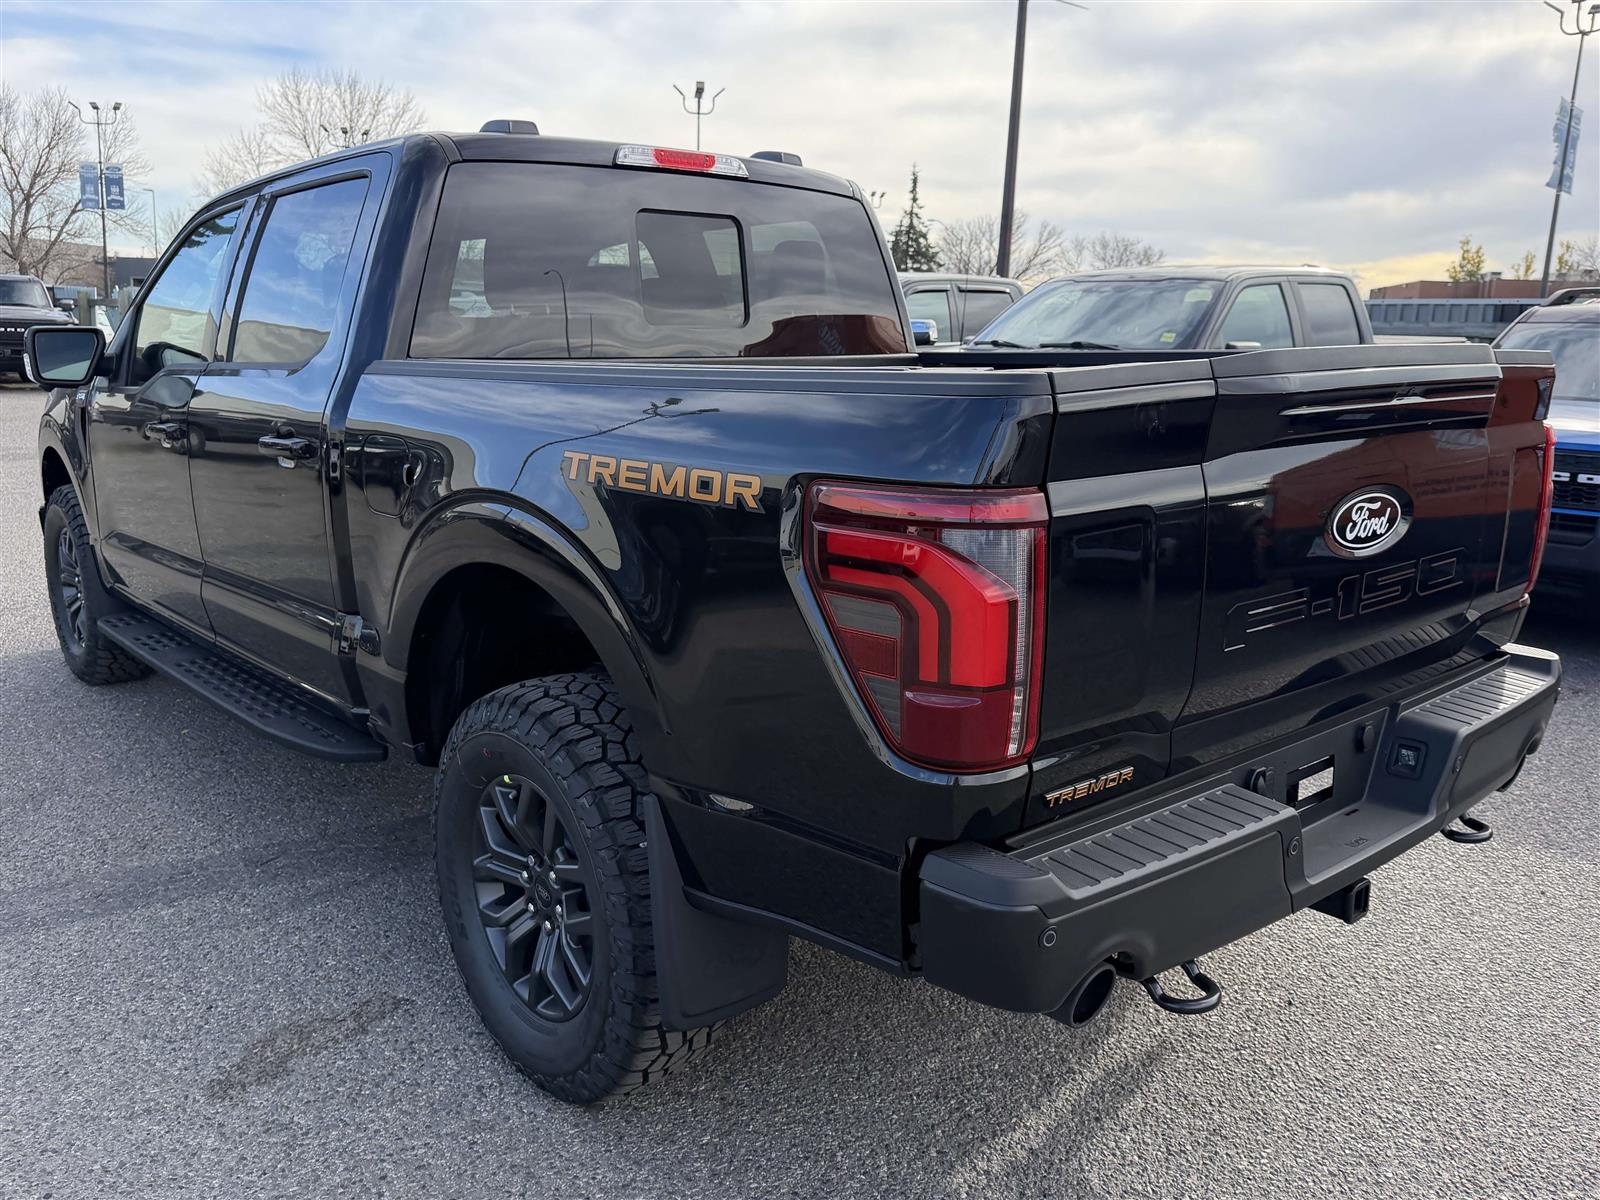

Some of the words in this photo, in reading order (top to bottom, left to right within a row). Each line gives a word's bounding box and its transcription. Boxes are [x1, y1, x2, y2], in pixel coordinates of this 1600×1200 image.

[562, 450, 764, 511] TREMOR
[1345, 501, 1390, 541] Ford
[1223, 547, 1465, 652] F-150
[1044, 766, 1135, 808] TREMOR
